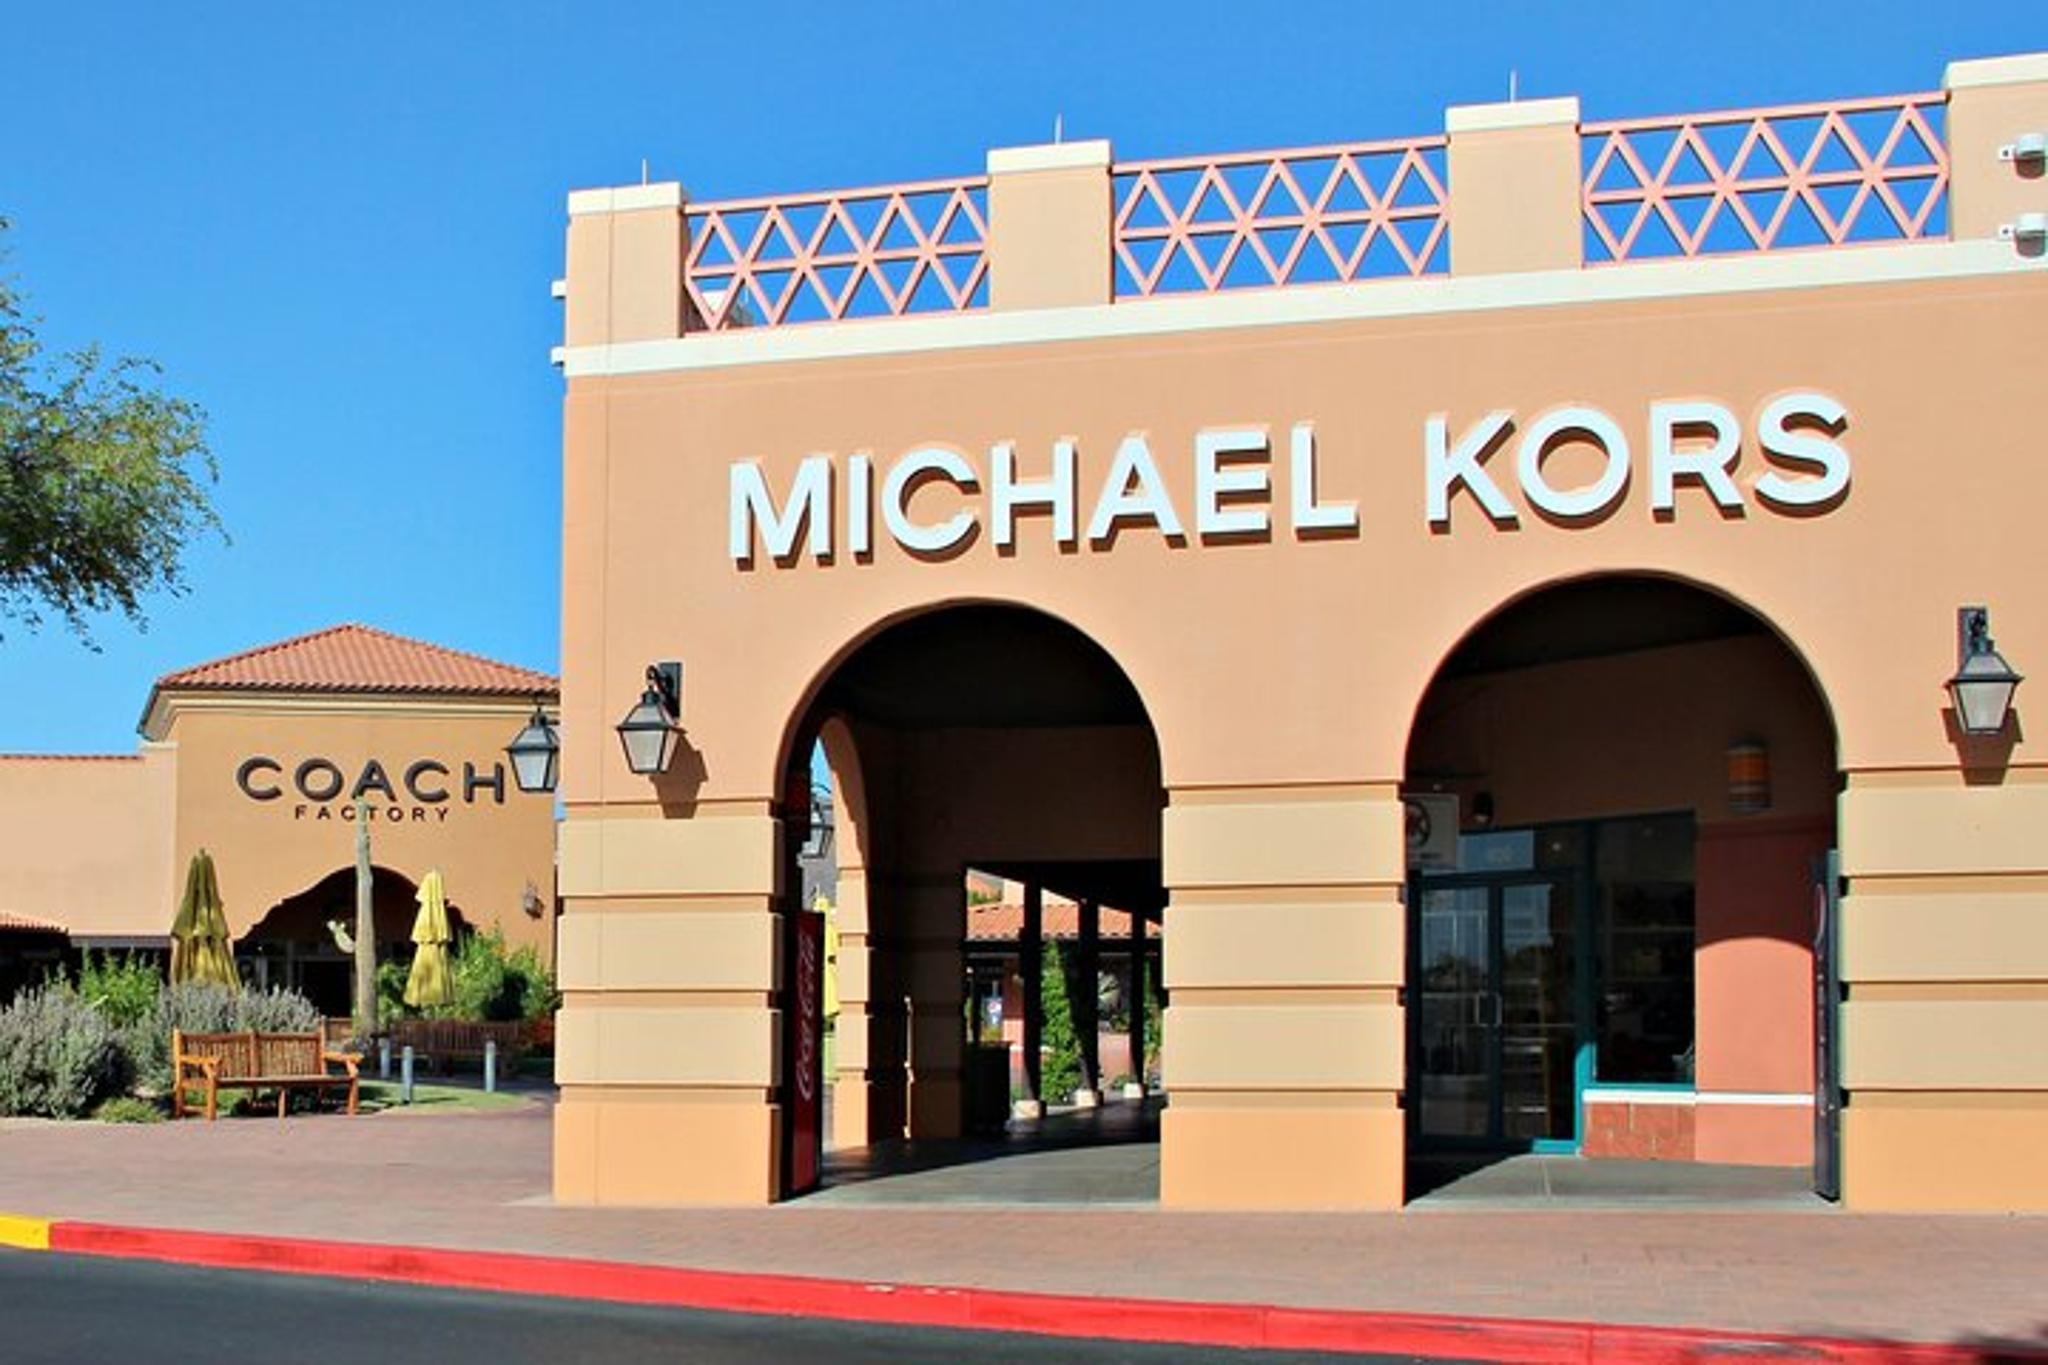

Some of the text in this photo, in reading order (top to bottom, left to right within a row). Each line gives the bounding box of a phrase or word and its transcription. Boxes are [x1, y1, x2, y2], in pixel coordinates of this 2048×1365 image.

[729, 392, 1852, 569] MICHAEL KORS
[236, 757, 504, 804] COACH
[295, 804, 449, 822] FACTORY
